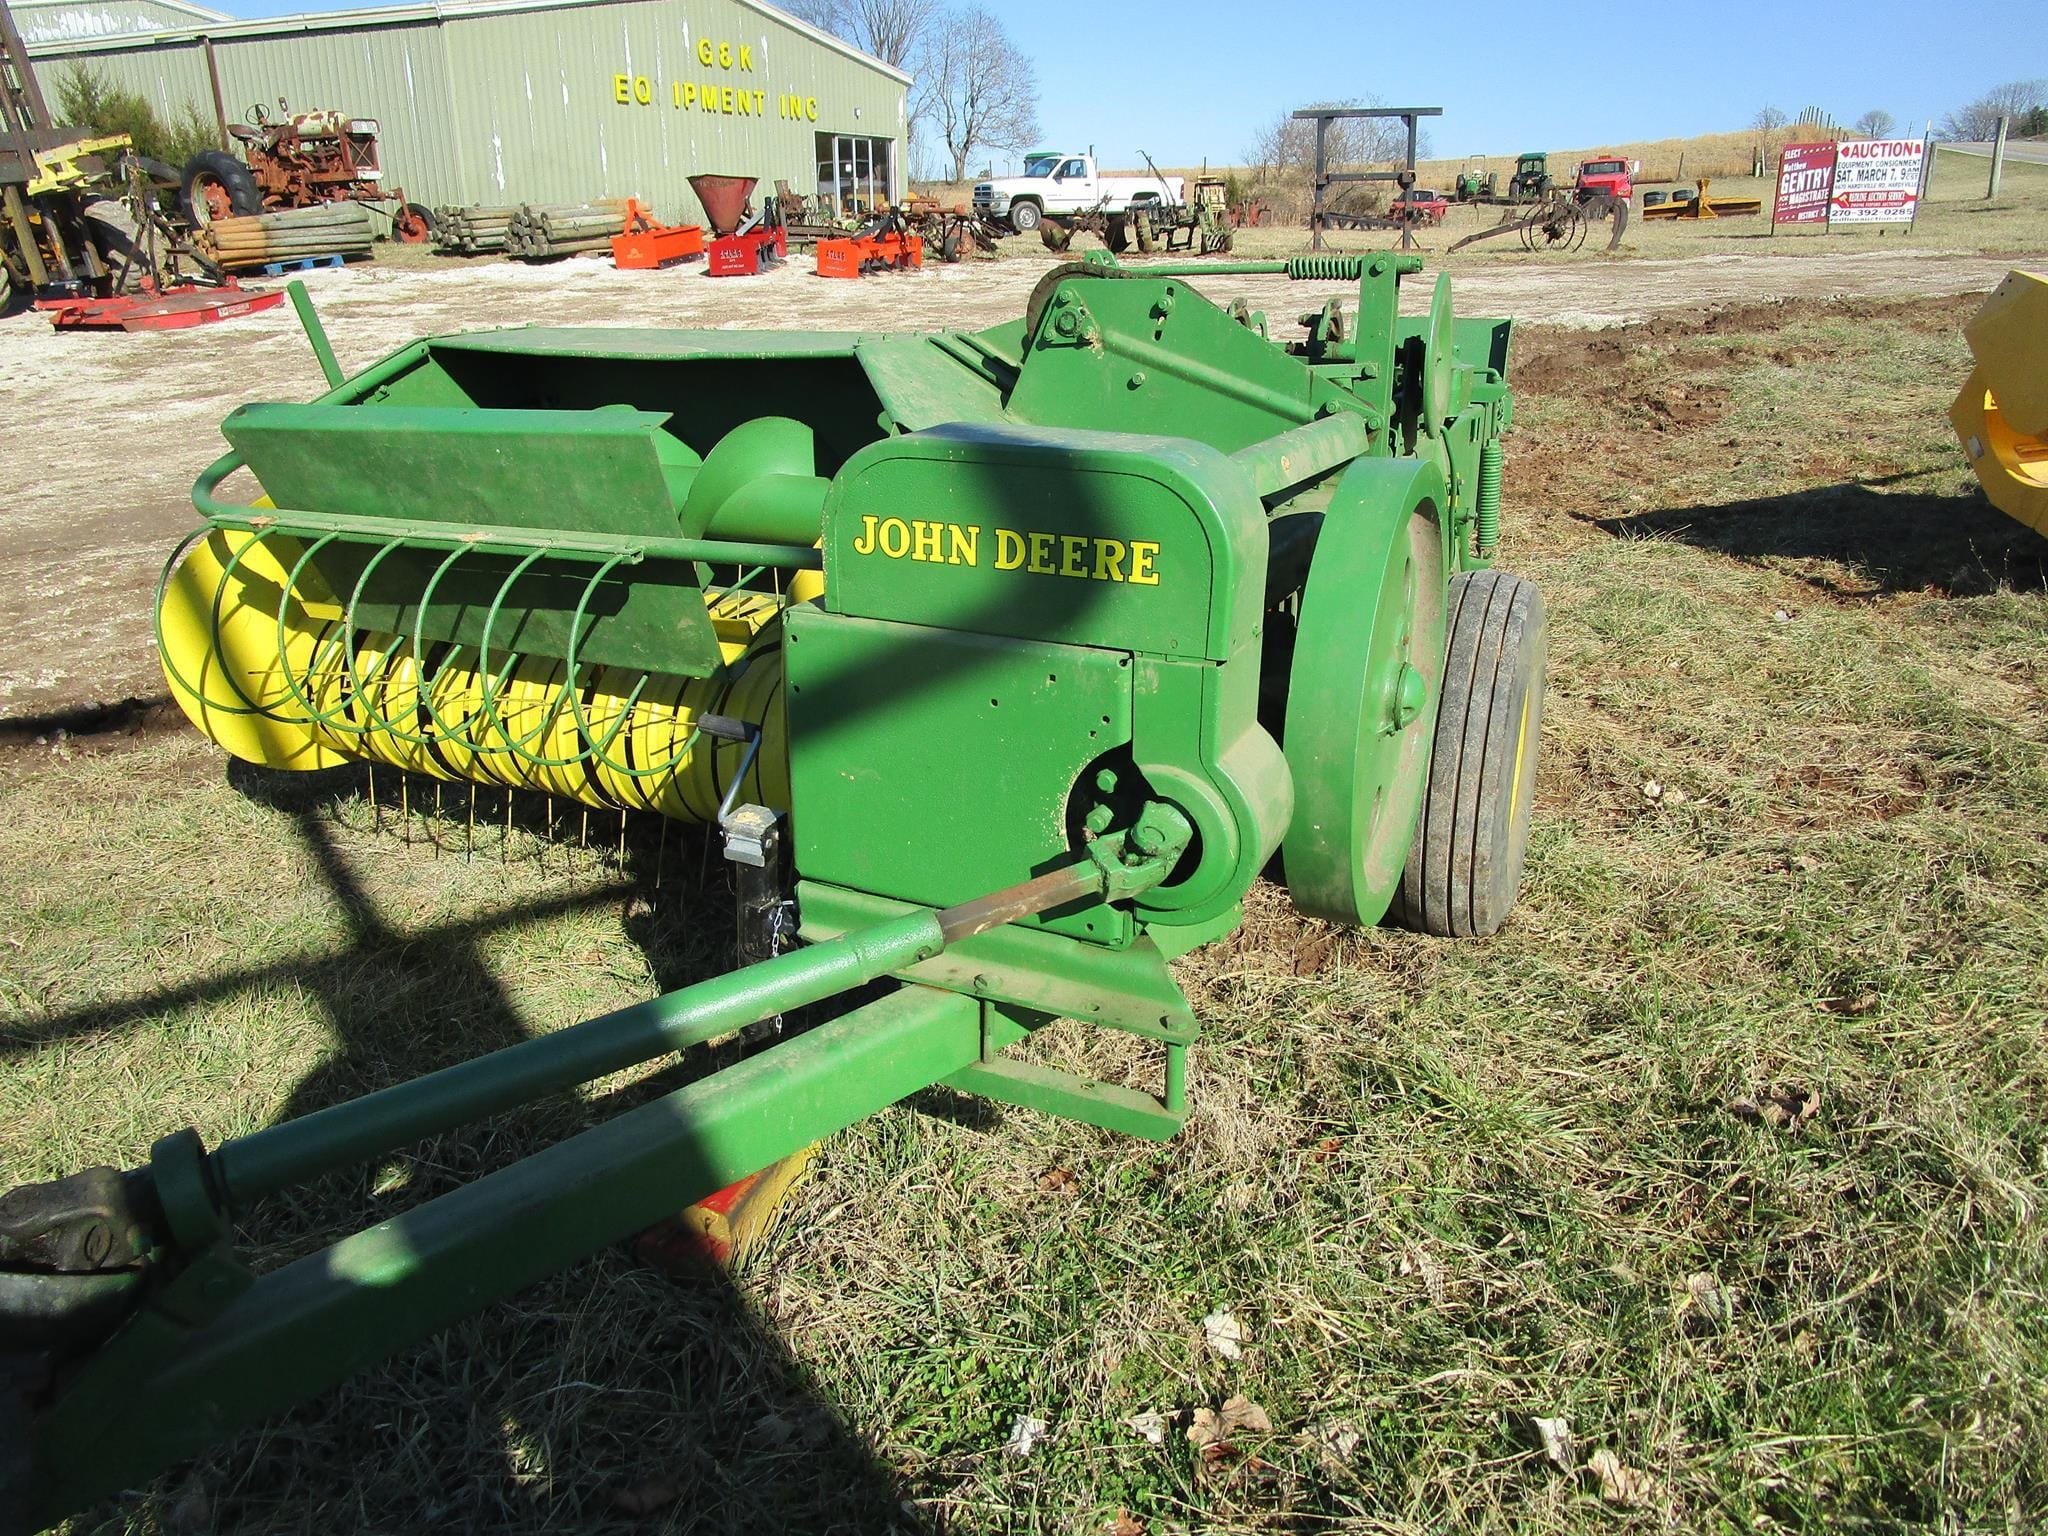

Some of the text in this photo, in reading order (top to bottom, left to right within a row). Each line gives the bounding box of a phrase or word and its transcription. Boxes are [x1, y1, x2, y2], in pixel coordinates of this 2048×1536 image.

[697, 37, 754, 72] G&K
[780, 94, 819, 122] INC
[1784, 149, 1801, 160] ELECT
[1850, 142, 1914, 158] AUCTION
[1838, 158, 1921, 169] EQUIPMENT CONSIGNMENT
[1780, 167, 1832, 195] GENTRY
[1836, 170, 1854, 183] SAT.
[1856, 168, 1887, 181] MARCH
[1900, 167, 1907, 180] 9
[1789, 188, 1829, 205] MAGISTRATE
[1820, 207, 1827, 217] 3
[1831, 208, 1913, 217] 270-392-0285
[853, 514, 1161, 586] JOHN DEERE
